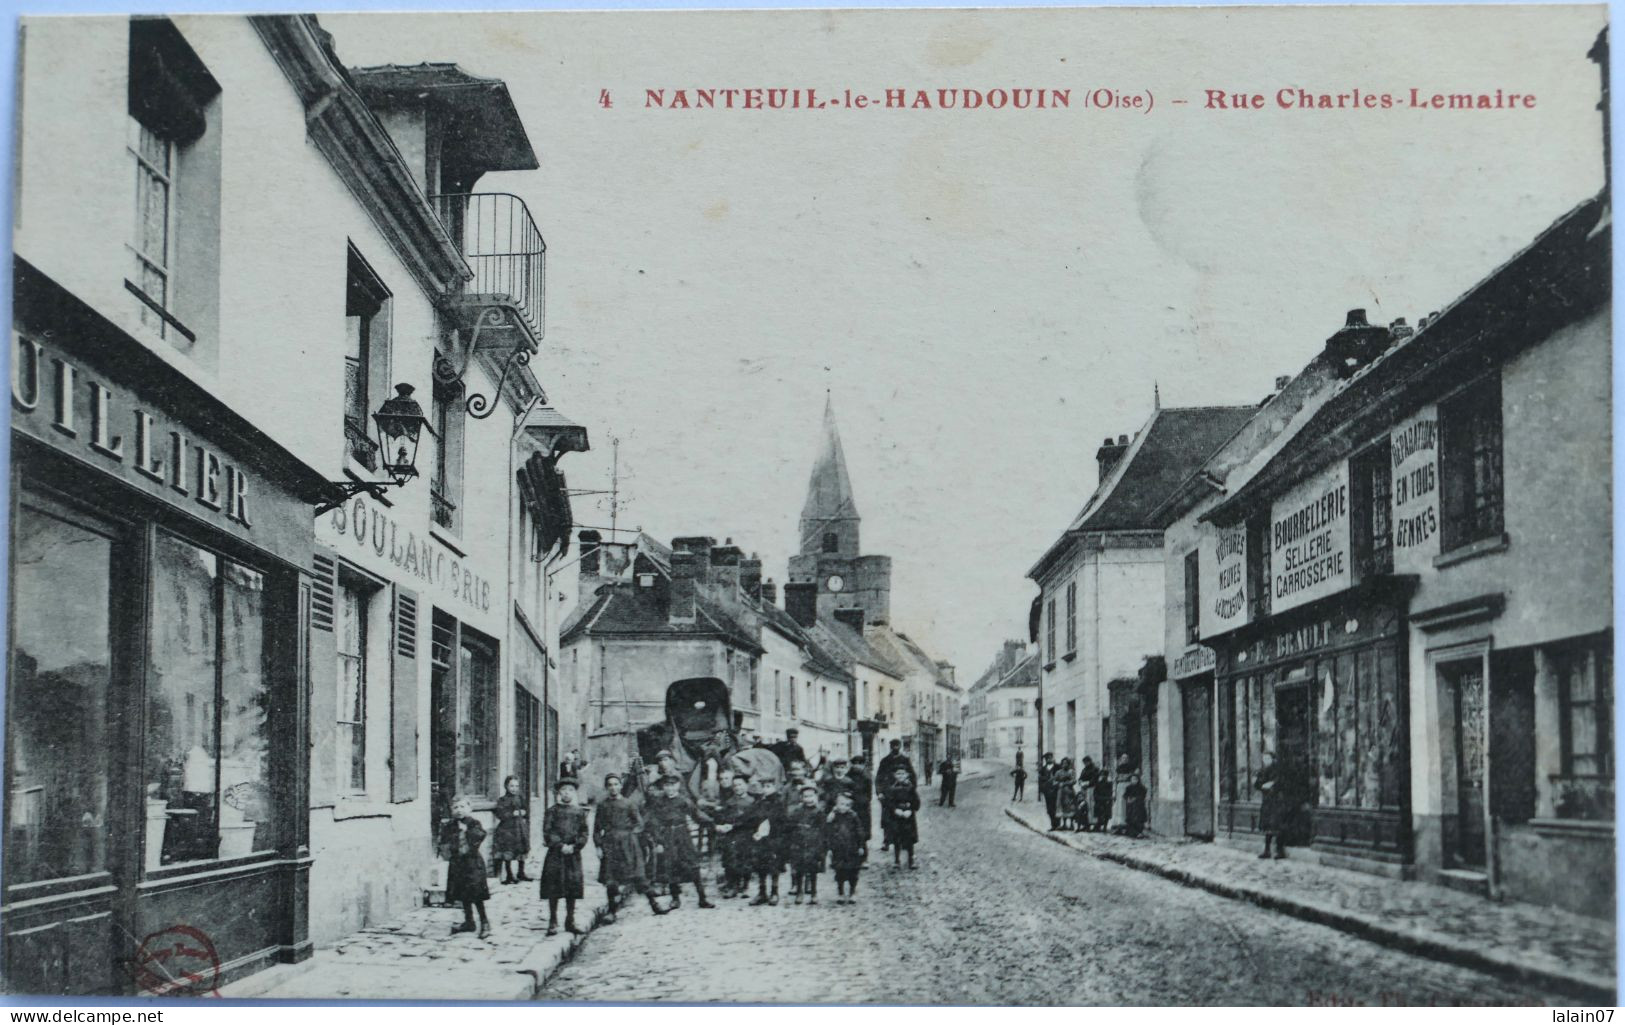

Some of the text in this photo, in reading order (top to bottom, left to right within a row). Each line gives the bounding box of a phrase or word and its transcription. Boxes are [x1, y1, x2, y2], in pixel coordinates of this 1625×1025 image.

[1396, 462, 1435, 506] EN TOUS
[1275, 485, 1346, 552] BOURRELLERIE
[1396, 506, 1437, 548] GENRES
[1216, 533, 1245, 566] VOITURES
[1285, 529, 1332, 571] SELLERIE
[1219, 562, 1241, 591] NEUVES
[1276, 551, 1344, 598] CARROSSERIE
